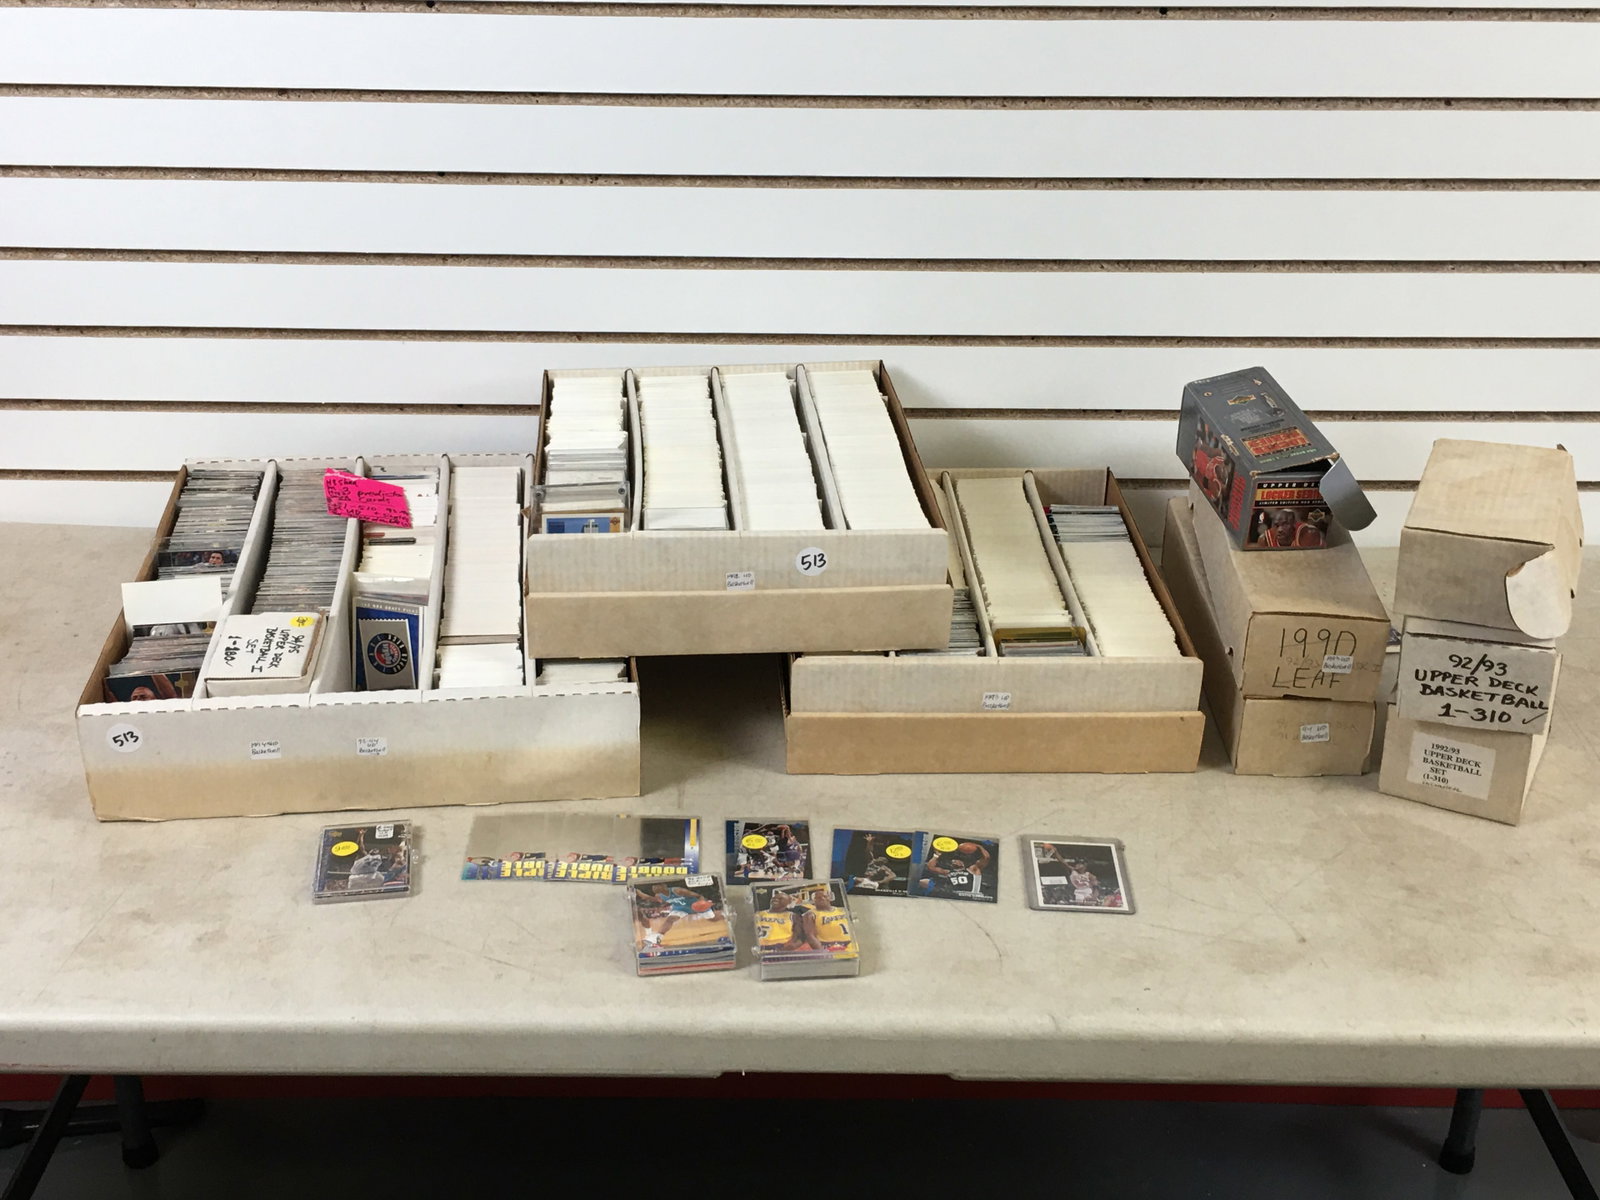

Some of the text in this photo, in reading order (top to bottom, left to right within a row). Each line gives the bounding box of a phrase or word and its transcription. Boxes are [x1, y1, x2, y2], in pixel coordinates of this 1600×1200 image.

[801, 552, 827, 571] 513
[246, 639, 259, 654] SET
[1448, 653, 1508, 677] 92/93
[1414, 668, 1539, 697] UPPER DECK
[1420, 683, 1549, 710] BASKETBALL
[1438, 702, 1512, 723] 1-310
[112, 730, 139, 747] 513
[1431, 743, 1461, 754] 1992/93
[1422, 757, 1482, 776] BASKETBALL
[1424, 749, 1482, 768] UPPER DECK
[1422, 773, 1449, 785] (1-310)
[1430, 766, 1448, 776] SET
[554, 869, 613, 881] RIPLE
[616, 865, 688, 875] DOUBLE
[950, 876, 969, 886] 50
